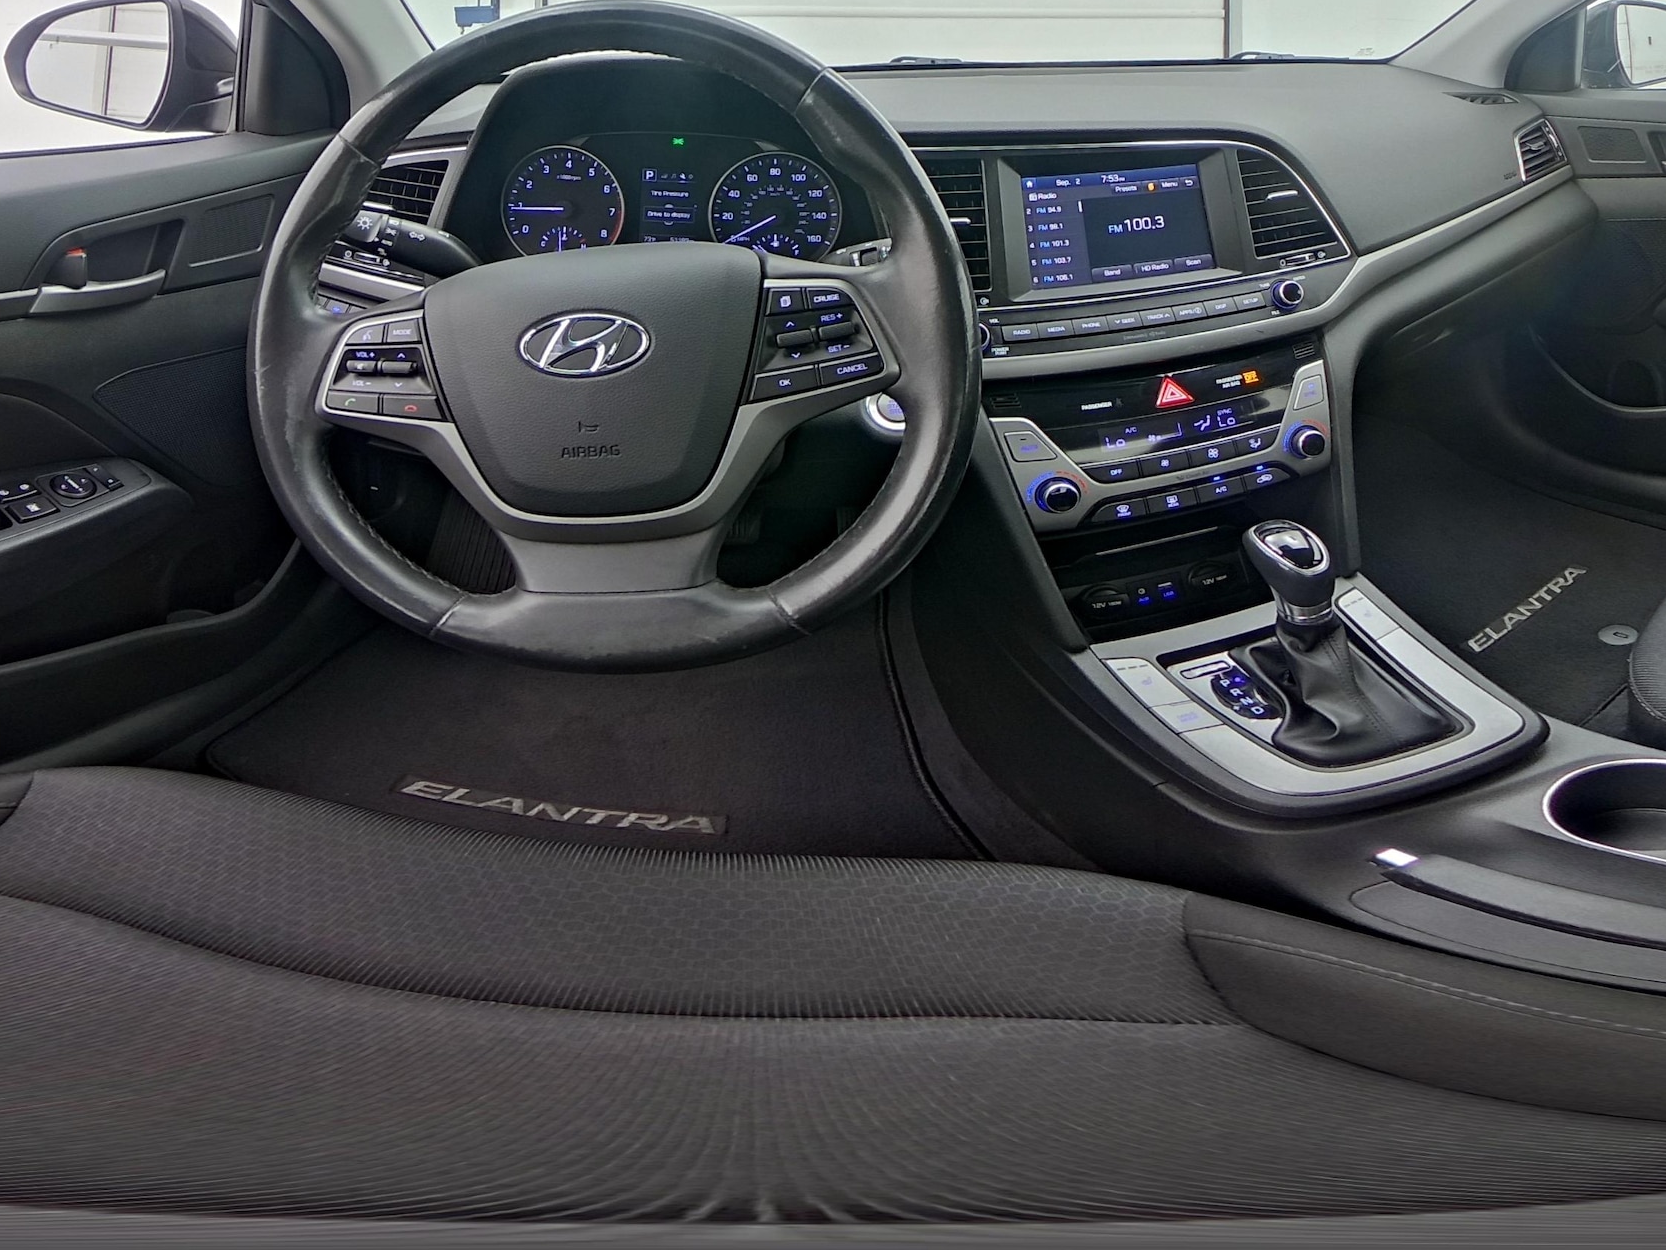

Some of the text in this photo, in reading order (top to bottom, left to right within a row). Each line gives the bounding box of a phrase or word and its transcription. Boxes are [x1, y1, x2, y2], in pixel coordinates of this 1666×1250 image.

[565, 160, 572, 169] 4
[543, 165, 550, 174] 3
[588, 168, 596, 177] 5
[769, 168, 781, 176] 80
[645, 170, 654, 180] P
[746, 174, 758, 182] 60
[526, 180, 533, 189] 2
[603, 185, 611, 193] 6
[728, 190, 740, 198] 40
[1038, 192, 1057, 200] Radio
[608, 208, 616, 216] 7
[722, 212, 733, 220] 20
[522, 225, 529, 233] 0
[1108, 216, 1165, 234] FM 100.3
[600, 229, 608, 238] 8
[806, 235, 821, 243] 160
[1051, 239, 1069, 247] 101.3
[1104, 268, 1121, 276] Band
[1151, 262, 1169, 270] Radio
[1185, 258, 1202, 266] Scan
[814, 294, 840, 303] CRUISE
[837, 363, 868, 374] CANCEL
[779, 379, 791, 387] OK
[1081, 401, 1113, 411] PASSENGER
[561, 445, 621, 458] AIRBAG
[1467, 567, 1587, 653] ELANTRA
[1220, 678, 1230, 688] P
[1230, 688, 1243, 697] R
[1239, 696, 1254, 706] N
[1251, 706, 1264, 715] D
[400, 781, 717, 835] ELANTRA
